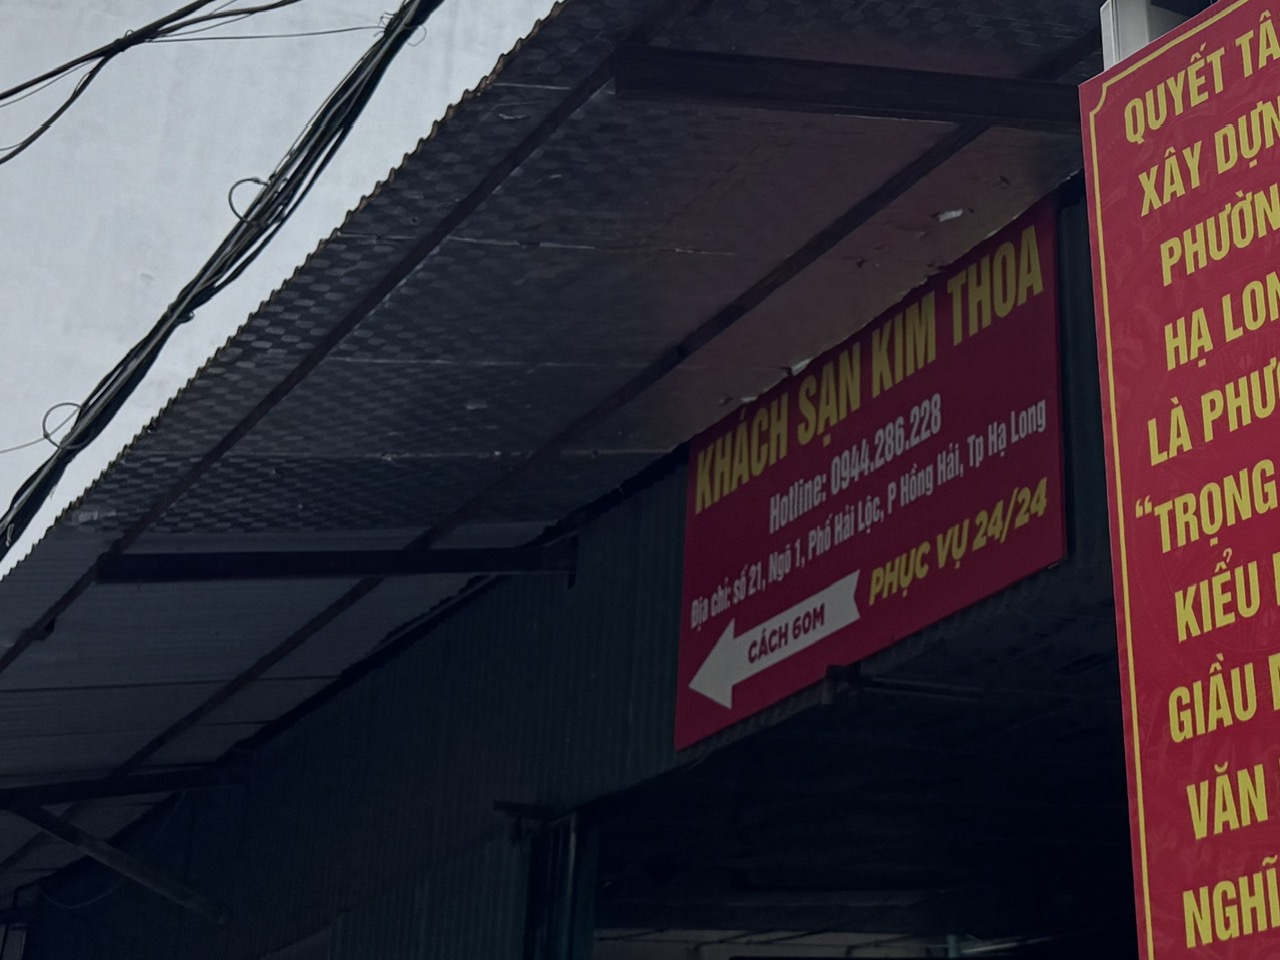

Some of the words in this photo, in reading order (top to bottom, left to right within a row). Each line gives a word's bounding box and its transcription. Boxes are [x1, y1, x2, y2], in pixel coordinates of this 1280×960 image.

[1124, 41, 1225, 144] QUYẾT
[1137, 142, 1204, 218] XÂY
[694, 400, 789, 515] KHÁCH
[796, 343, 861, 448] SẠN
[871, 290, 937, 400] KIM
[946, 224, 1044, 347] THOA
[1163, 306, 1213, 372] HẠ
[769, 474, 827, 534] Hotline:
[830, 393, 943, 496] 0944.286.228
[1146, 396, 1193, 467] LÀ
[690, 597, 709, 632] Địa
[748, 562, 766, 593] 21,
[768, 545, 791, 586] Ngõ
[793, 537, 806, 571] 1,
[808, 514, 833, 560] Phố
[834, 507, 855, 548] Hải
[856, 496, 885, 535] Lộc,
[886, 482, 897, 515] P
[900, 458, 934, 503] Hồng
[936, 443, 965, 488] Hải,
[967, 435, 985, 474] Tp
[987, 423, 1007, 458] Hạ
[1010, 398, 1047, 446] Long
[868, 541, 931, 605] PHỤC
[935, 521, 970, 571] VỤ
[971, 476, 1049, 553] 24/24
[1134, 458, 1279, 555] “TRỌNG
[746, 619, 790, 665] CÁCH
[793, 602, 826, 640] 60M
[1174, 547, 1262, 644] KIỂU
[1168, 652, 1258, 744] GIẦU
[1185, 761, 1269, 841] VĂN
